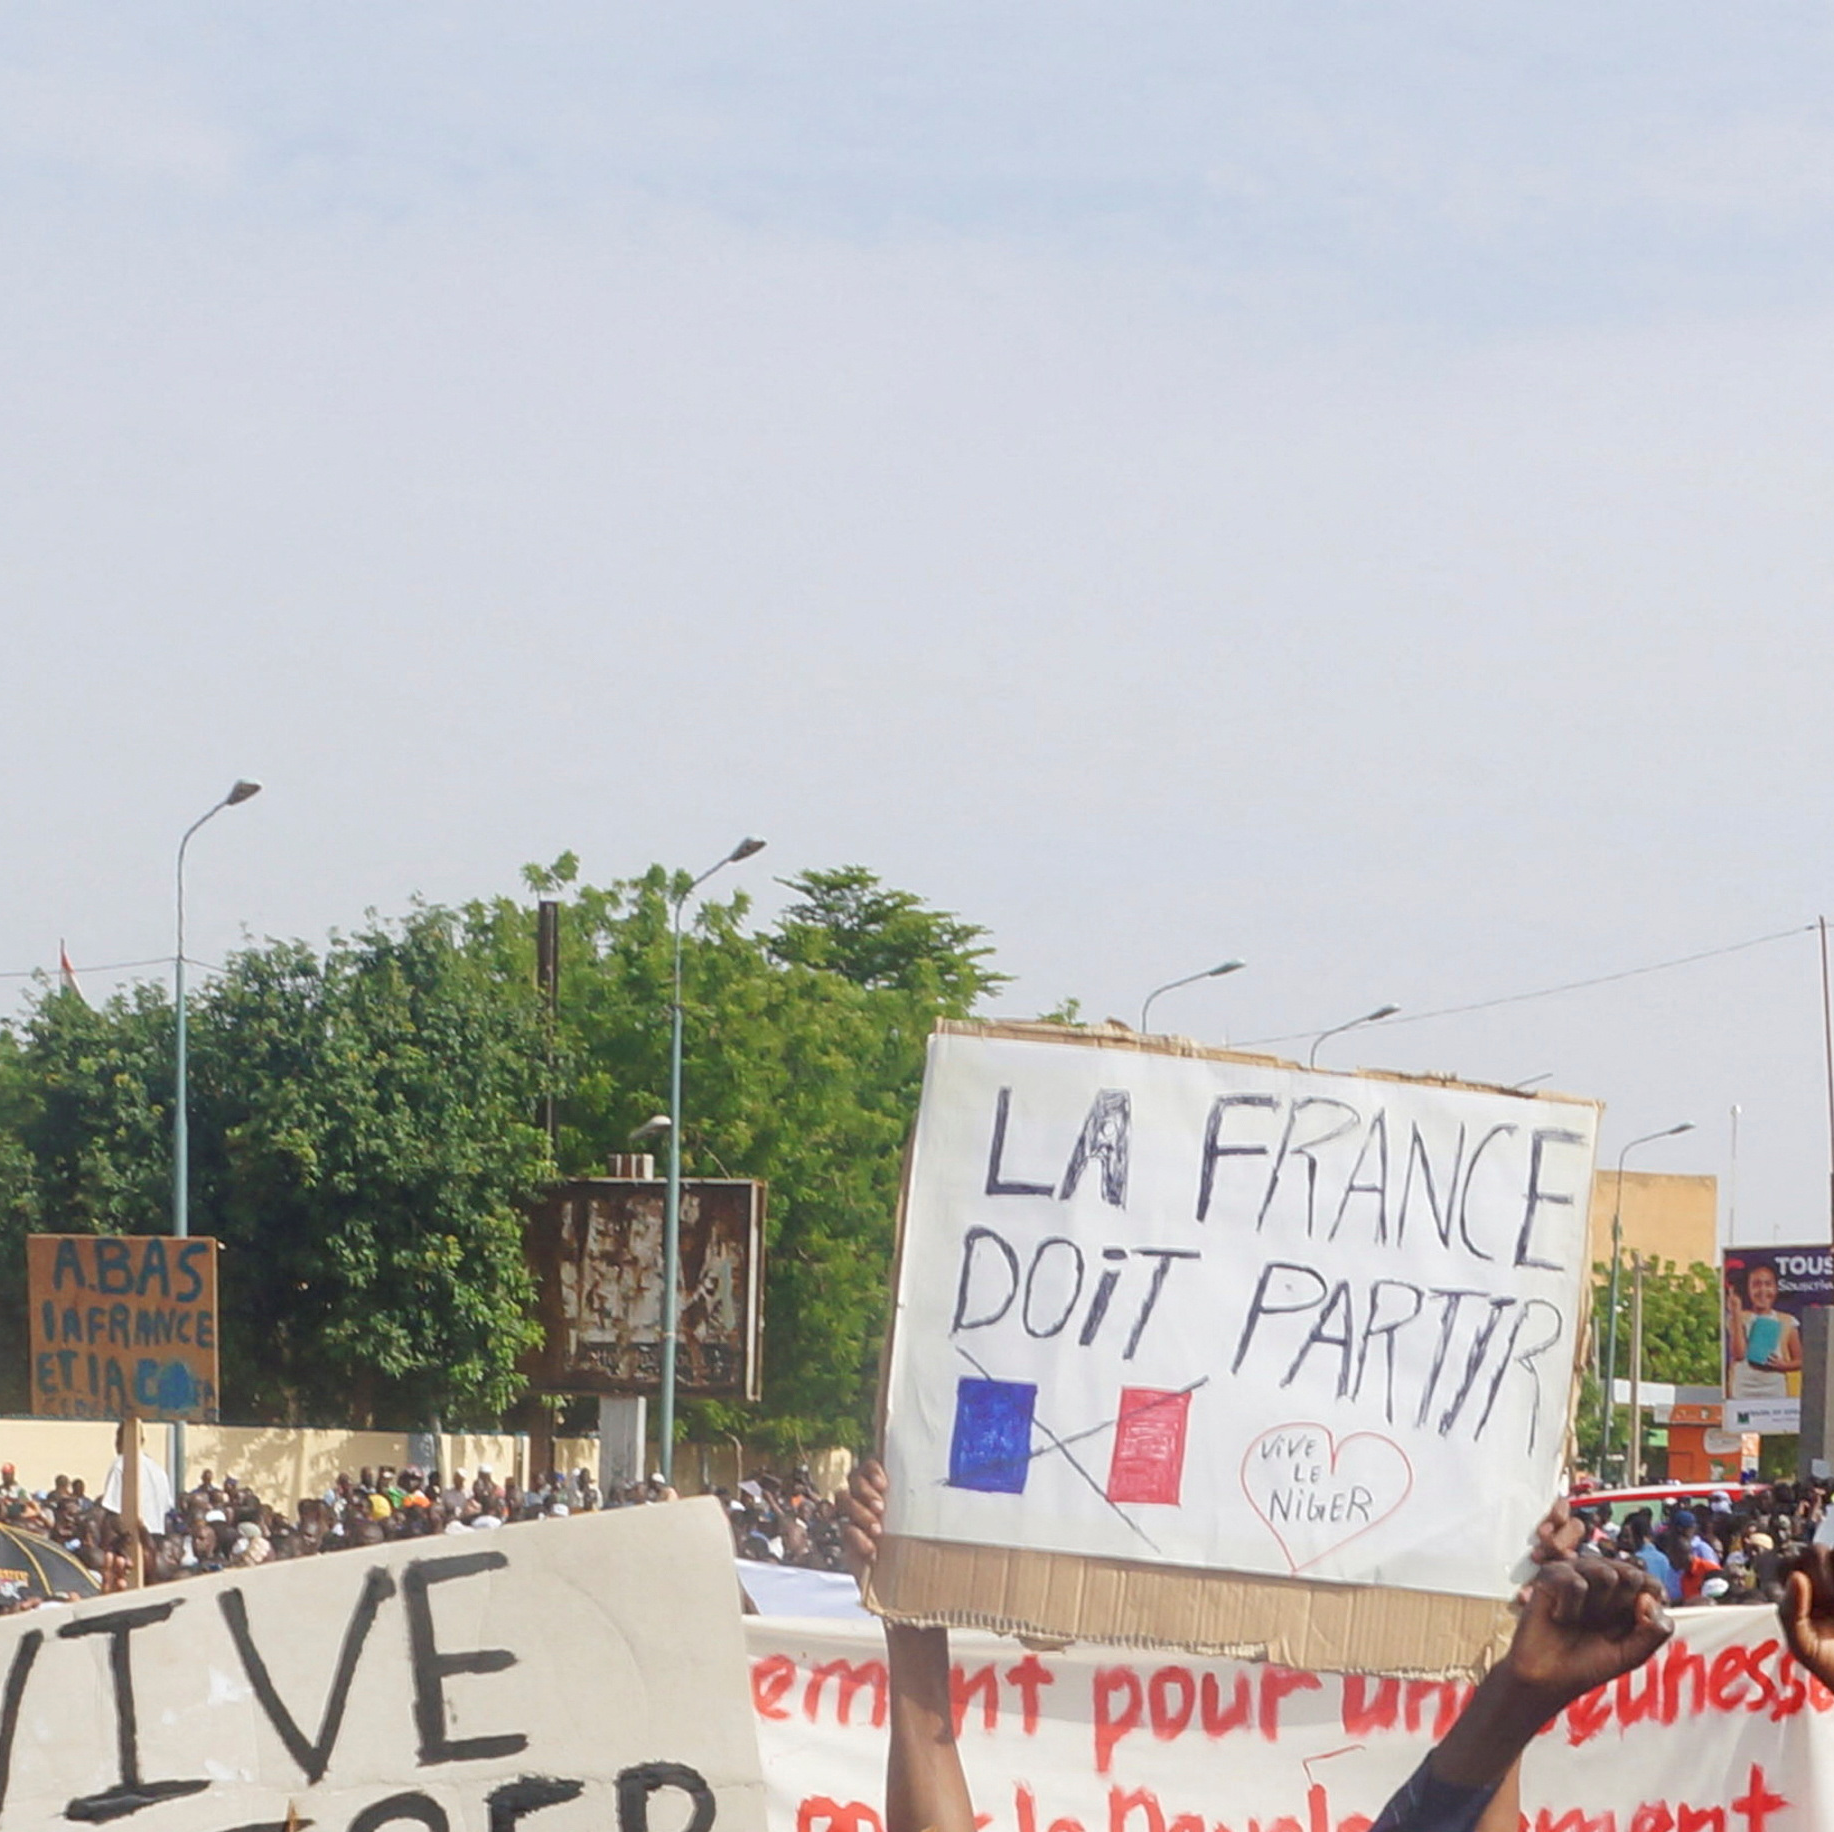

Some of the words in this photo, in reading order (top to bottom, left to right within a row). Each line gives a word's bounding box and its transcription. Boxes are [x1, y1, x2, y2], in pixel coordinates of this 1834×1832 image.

[984, 1086, 1131, 1210] LA
[1195, 1091, 1589, 1271] FRANCE
[1774, 1255, 1834, 1276] TOUS
[36, 1350, 79, 1394] ET
[1230, 1260, 1564, 1457] PARTIR
[1294, 1462, 1322, 1484] LE
[1093, 1661, 1323, 1774] pour
